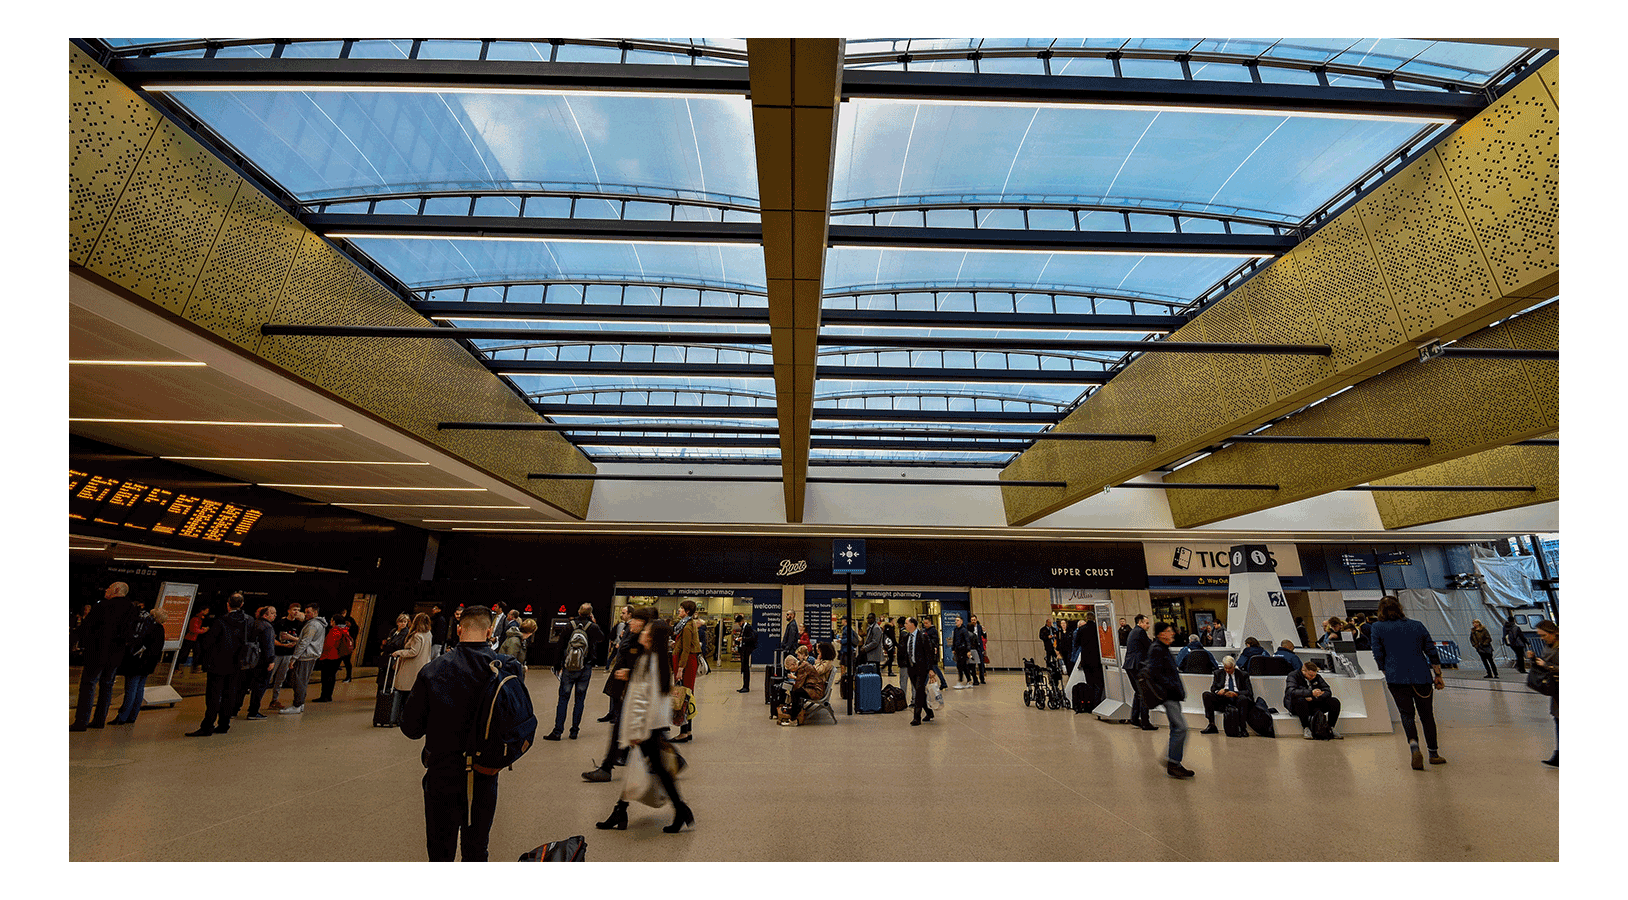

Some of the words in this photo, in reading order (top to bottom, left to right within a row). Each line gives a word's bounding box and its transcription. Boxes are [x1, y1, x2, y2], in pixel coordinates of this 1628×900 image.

[1196, 551, 1278, 568] TICS
[776, 560, 808, 576] Boots
[1051, 567, 1081, 577] UPPER
[1085, 568, 1115, 577] CRUST
